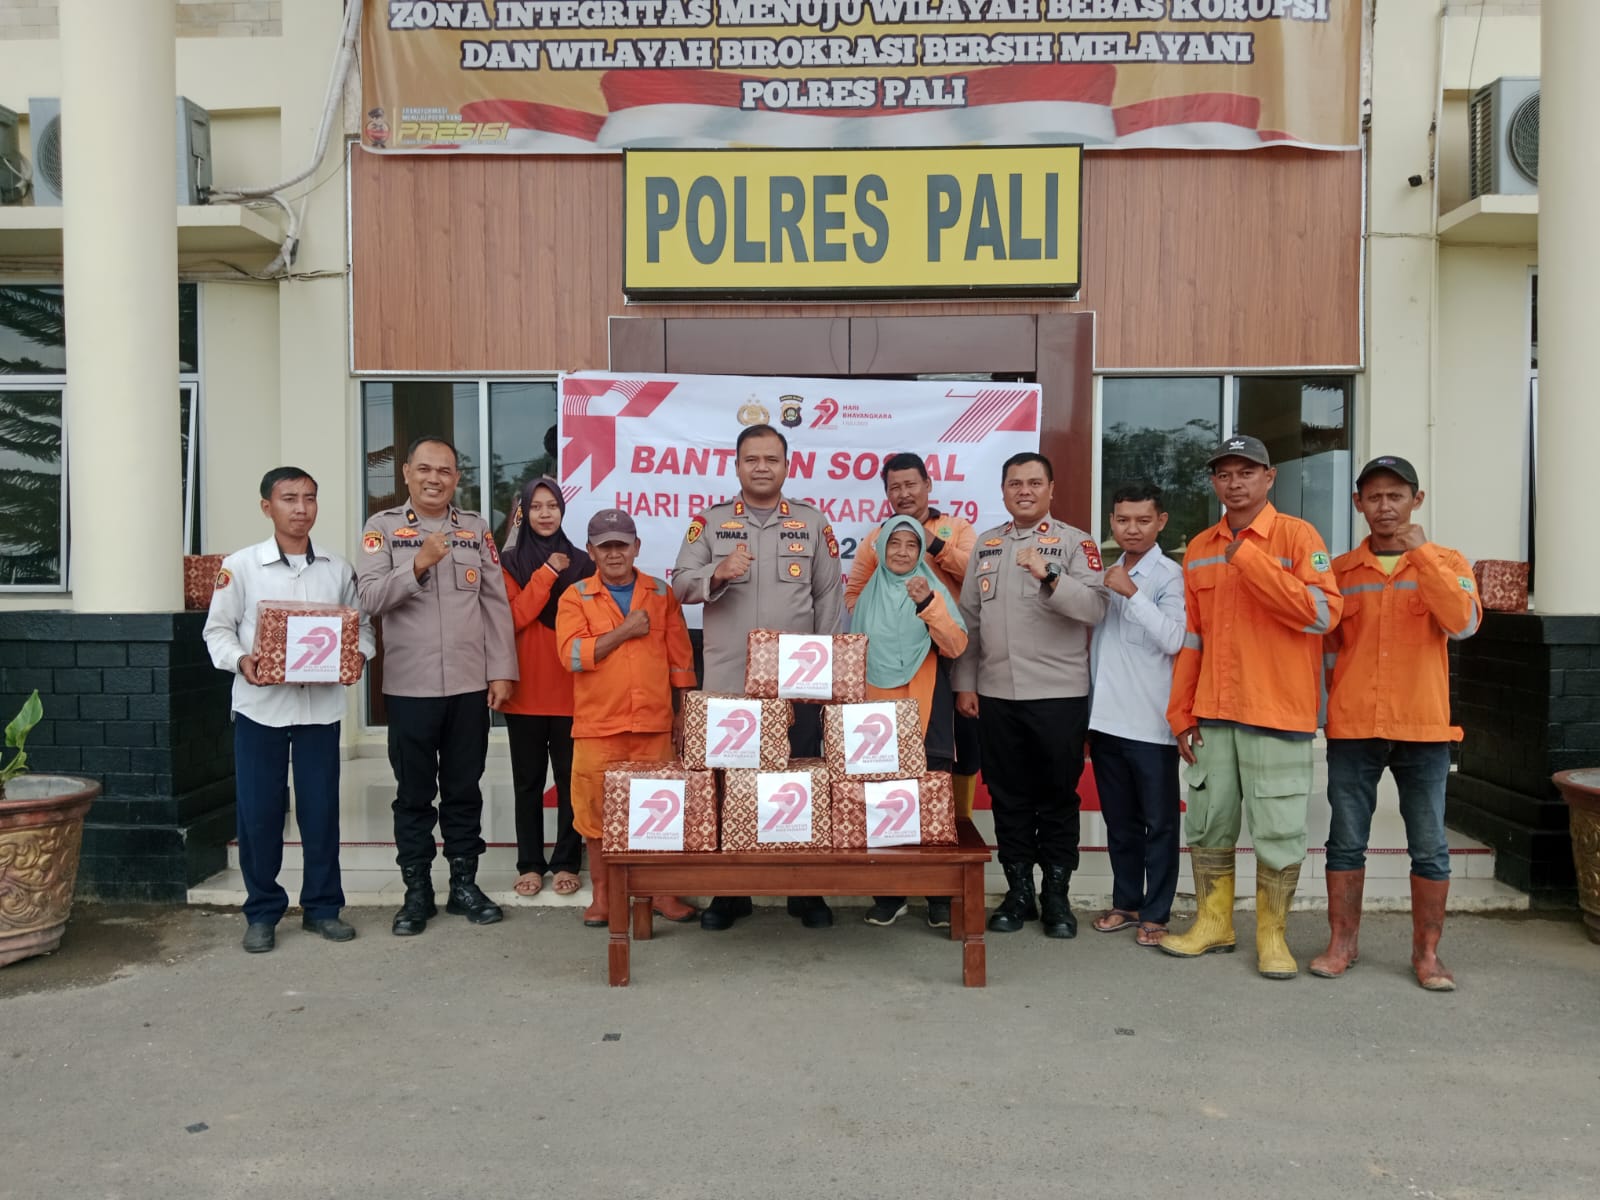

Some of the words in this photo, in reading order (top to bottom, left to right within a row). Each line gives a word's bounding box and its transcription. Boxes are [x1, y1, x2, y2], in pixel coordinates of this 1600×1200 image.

[390, 1, 491, 29] ZONA
[496, 0, 713, 27] INTEGRITAS
[717, 0, 862, 31] MENUJU
[872, 0, 1040, 21] WILAYAH
[1046, 0, 1165, 20] BEBAS
[1170, 0, 1329, 20] KORUPSI
[462, 41, 541, 70] DAN
[545, 39, 714, 69] WILAYAH
[718, 36, 917, 67] BIROKRASI
[921, 33, 1054, 65] BERSIH
[1059, 33, 1254, 63] MELAYANI
[741, 79, 877, 108] POLRES
[882, 78, 967, 107] PALI
[400, 121, 510, 144] PRESISI
[645, 174, 890, 265] POLRES
[926, 172, 1059, 263] PALI
[630, 445, 816, 479] BANTN
[827, 451, 965, 481] SOAL
[615, 491, 679, 518] HARI
[452, 540, 480, 549] POLRI
[780, 531, 810, 540] POLRI
[1036, 547, 1062, 557] OLRI
